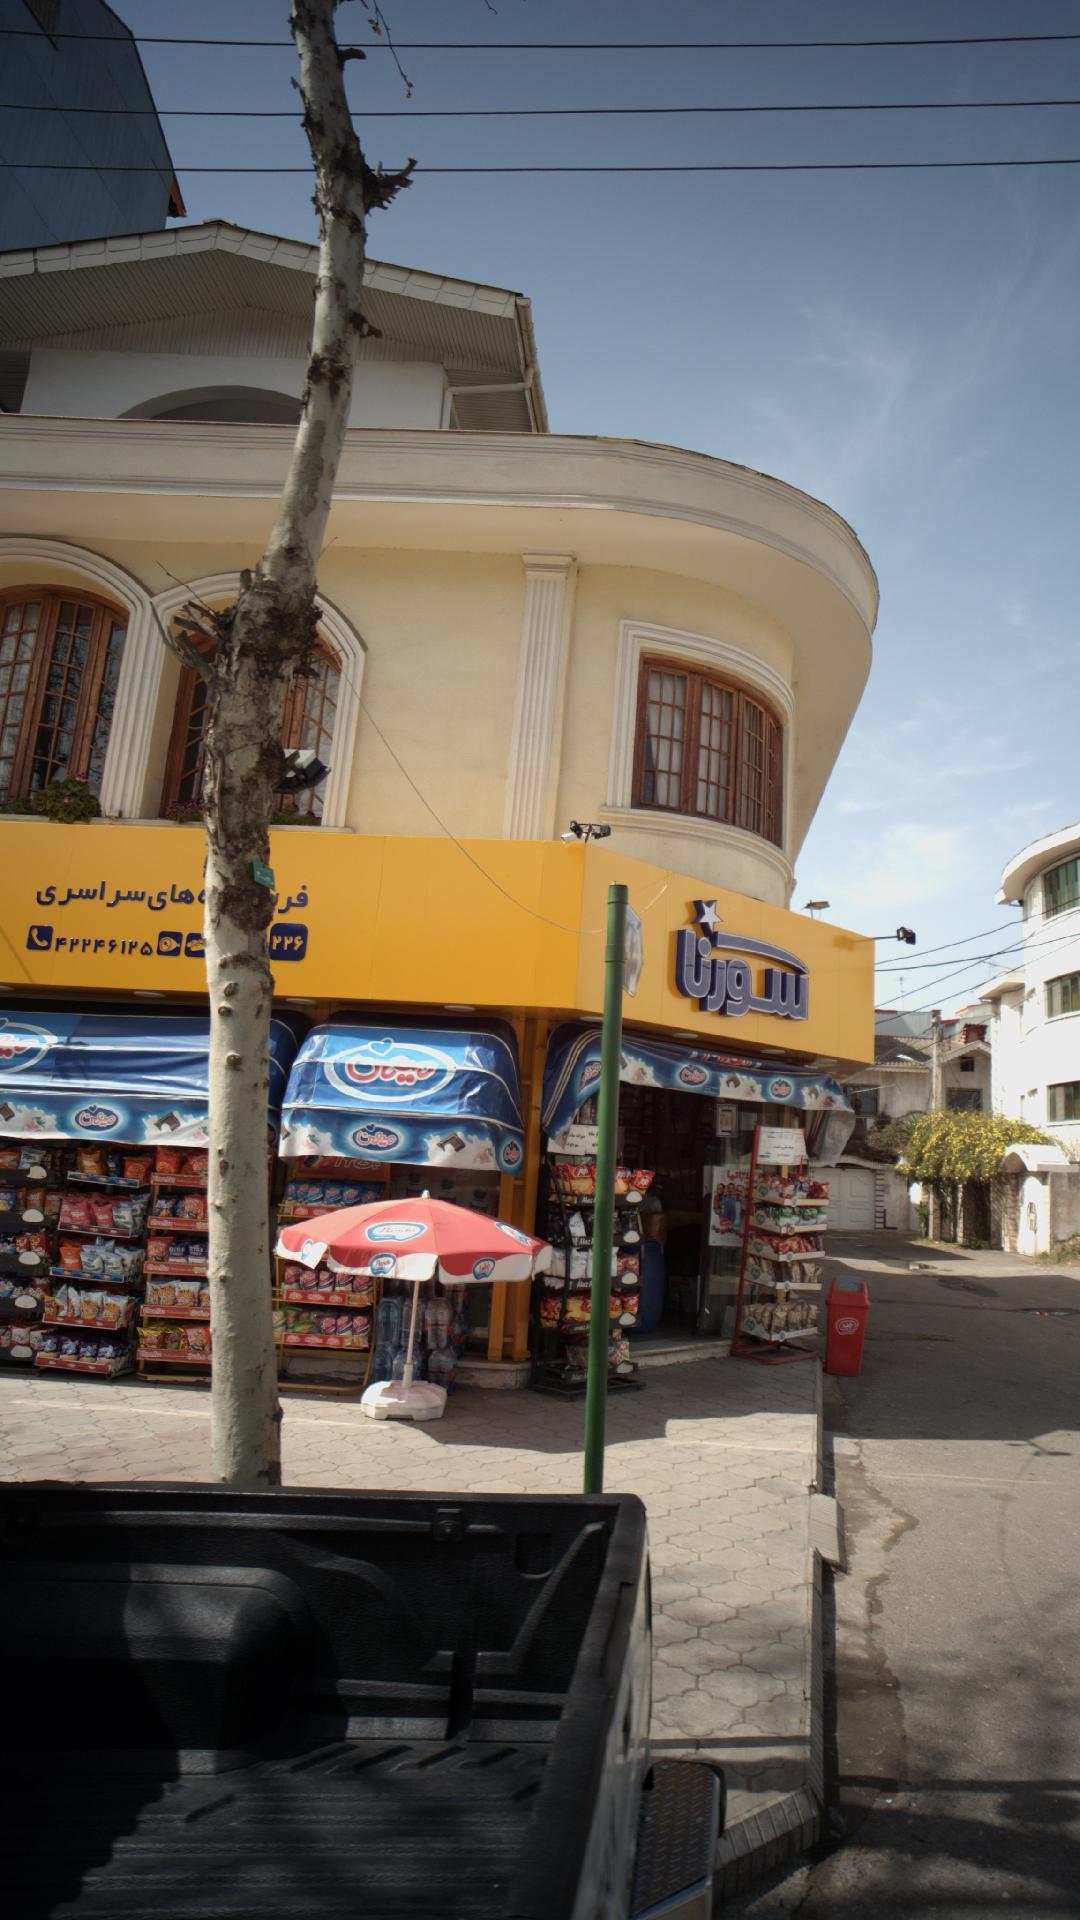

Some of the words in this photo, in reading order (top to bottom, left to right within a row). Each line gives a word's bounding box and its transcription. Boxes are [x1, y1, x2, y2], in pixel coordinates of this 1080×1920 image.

[36, 880, 146, 907] سراسری
[55, 937, 153, 956] ۴۲۲۴۶۱۲۵
[272, 935, 304, 951] ۲۲۶
[675, 929, 809, 1021] سورنا
